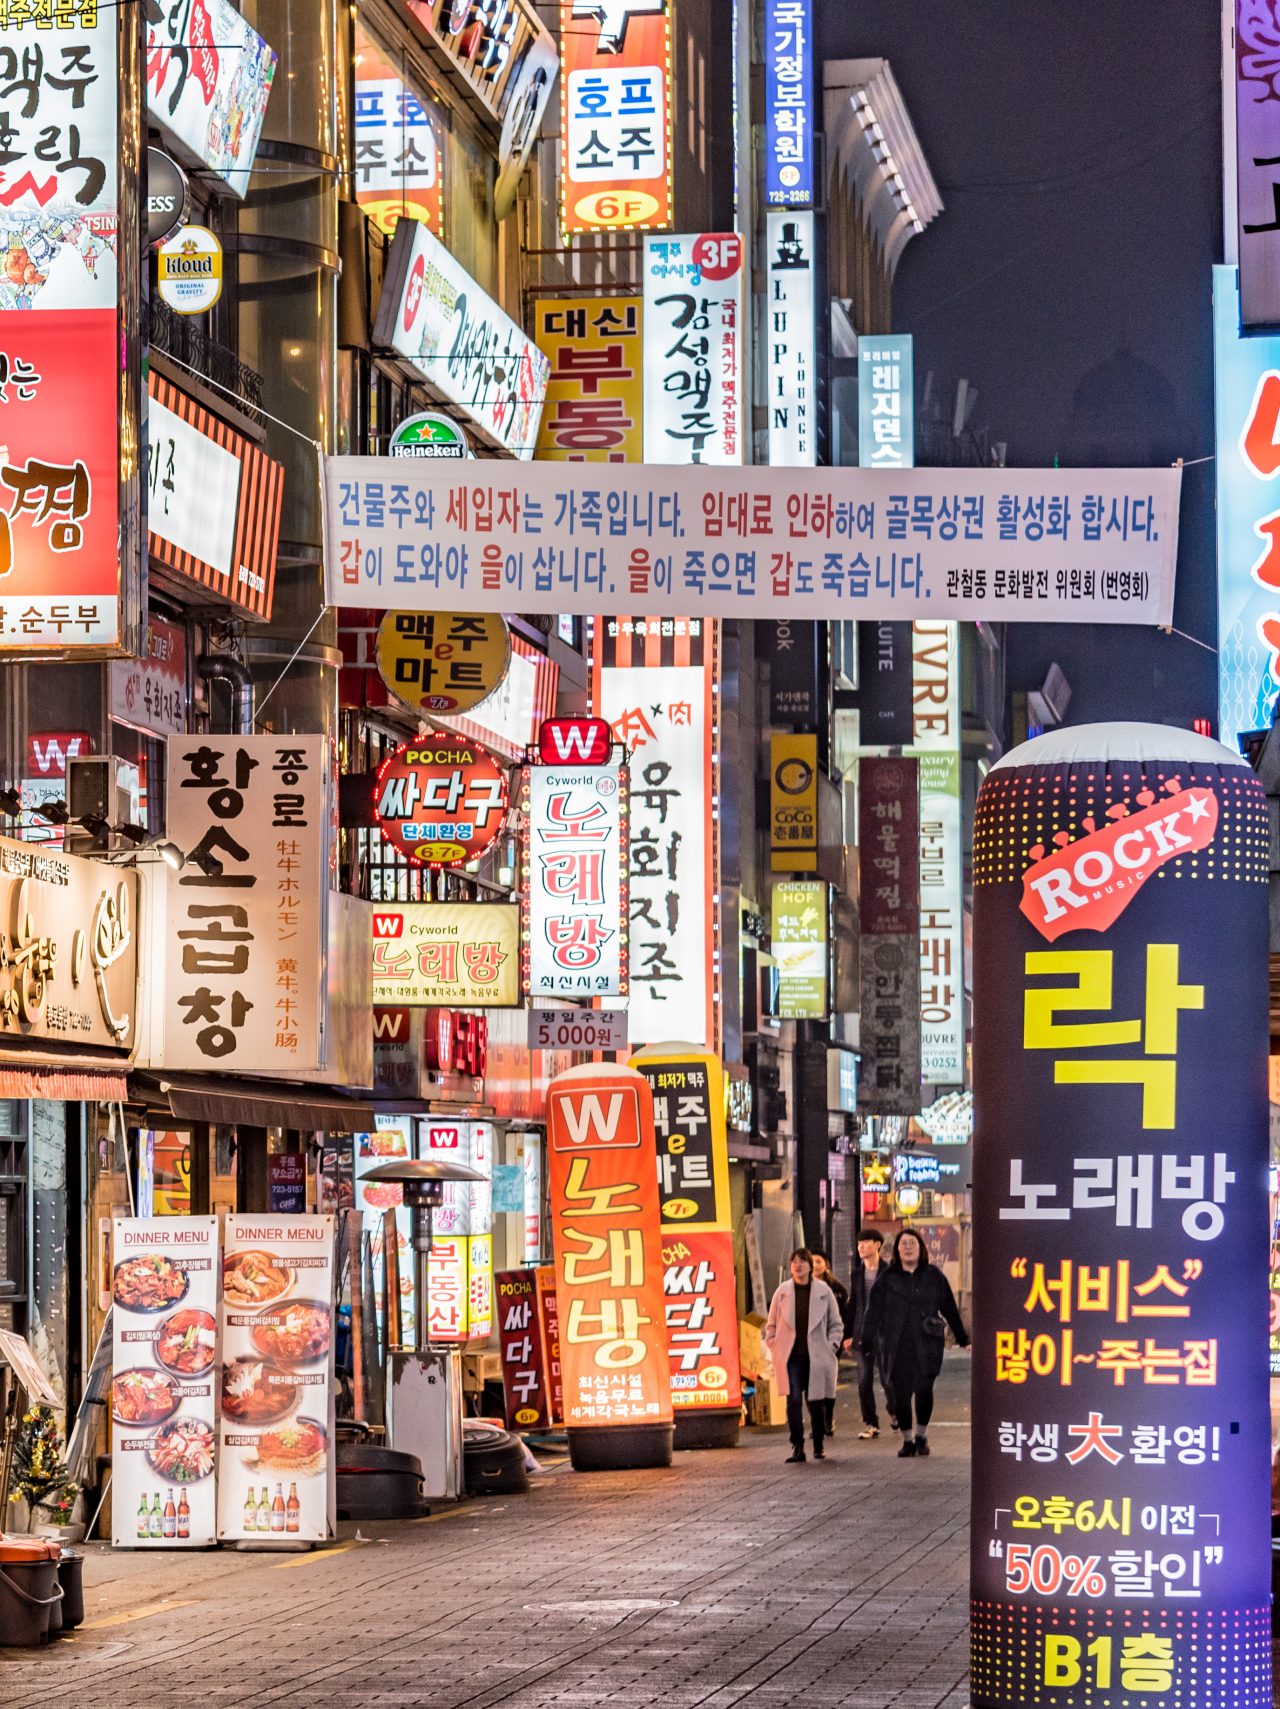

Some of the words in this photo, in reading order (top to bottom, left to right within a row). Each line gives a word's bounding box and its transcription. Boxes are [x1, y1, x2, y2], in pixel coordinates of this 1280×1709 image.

[575, 78, 656, 119] 호프
[772, 2, 806, 164] 국가정보학원
[576, 127, 656, 170] 소주
[594, 196, 642, 219] 6F
[166, 255, 213, 274] Kloud
[649, 243, 681, 263] 맥주
[701, 239, 738, 268] 3F
[544, 306, 637, 338] 대신
[654, 294, 719, 450] 감성맥주
[773, 280, 788, 429] LUPIN
[549, 345, 632, 464] 부동
[797, 352, 806, 453] LOUNGE
[870, 365, 903, 468] 레지던스
[394, 444, 461, 459] Heineken
[339, 481, 435, 530] 건물주와
[446, 486, 543, 534] 세입자는
[554, 489, 685, 537] 가족입니다.
[702, 491, 773, 538] 임대료
[786, 492, 875, 540] 인하하여
[886, 494, 984, 541] 골목상권
[997, 494, 1071, 541] 활성화
[1081, 494, 1159, 542] 합시다.
[339, 539, 382, 586] 갑이
[393, 543, 468, 589] 도와야
[480, 543, 523, 591] 을이
[532, 545, 615, 593] 삽니다.
[628, 547, 672, 595] 을이
[683, 550, 757, 597] 죽으면
[769, 551, 814, 597] 갑도
[821, 552, 931, 598] 죽습니다.
[946, 569, 987, 599] 관철동
[993, 569, 1049, 599] 문화발전
[1055, 569, 1096, 600] 위원회
[1100, 570, 1150, 601] (번영회)
[395, 614, 489, 651] 맥주
[607, 620, 701, 638] 한우육회전문점
[394, 657, 486, 693] 마트
[430, 697, 449, 709] 7F
[33, 737, 81, 773] W
[406, 750, 473, 765] POCHA
[551, 725, 599, 760] W
[272, 749, 308, 827] 종로
[378, 770, 504, 827] 싸다구
[546, 775, 593, 786] Cyworld
[401, 823, 474, 841] 단체환영
[775, 810, 813, 824] CoCo
[537, 791, 616, 971] 노래방
[628, 760, 683, 1001] 육회지존
[1030, 811, 1192, 924] ROCK
[176, 746, 260, 1057] 황소곱창
[777, 882, 820, 892] CHICKEN
[783, 893, 814, 904] HOF
[1091, 871, 1145, 901] MUSIC
[375, 916, 400, 936] W
[410, 924, 459, 936] Cyworld
[373, 941, 508, 984] 노래방
[540, 975, 610, 990] 최신시설
[1023, 943, 1205, 1130] 락
[560, 1093, 624, 1144] W
[433, 1131, 456, 1146] W
[667, 1133, 686, 1154] e
[999, 1153, 1235, 1241] 노래방
[124, 1232, 170, 1244] DINNER
[174, 1231, 209, 1243] MENU
[235, 1227, 283, 1240] DINNER
[287, 1227, 325, 1240] MENU
[561, 1157, 652, 1370] 노래방
[427, 1244, 460, 1333] 부동산
[500, 1282, 533, 1295] POCHA
[664, 1261, 720, 1370] 싸다구
[504, 1301, 539, 1403] 싸다구
[995, 1328, 1218, 1387] 많이~주는집
[578, 1373, 644, 1390] 최신시설
[578, 1388, 645, 1403] 녹음무료
[520, 1410, 535, 1421] 6F
[570, 1402, 661, 1419] 세계각국노래
[998, 1420, 1059, 1462] 학생
[1066, 1411, 1124, 1466] 大
[1129, 1424, 1220, 1465] 환영!
[1011, 1495, 1132, 1536] 오후6시
[1141, 1504, 1196, 1535] 이전
[1044, 1632, 1174, 1692] B1층
